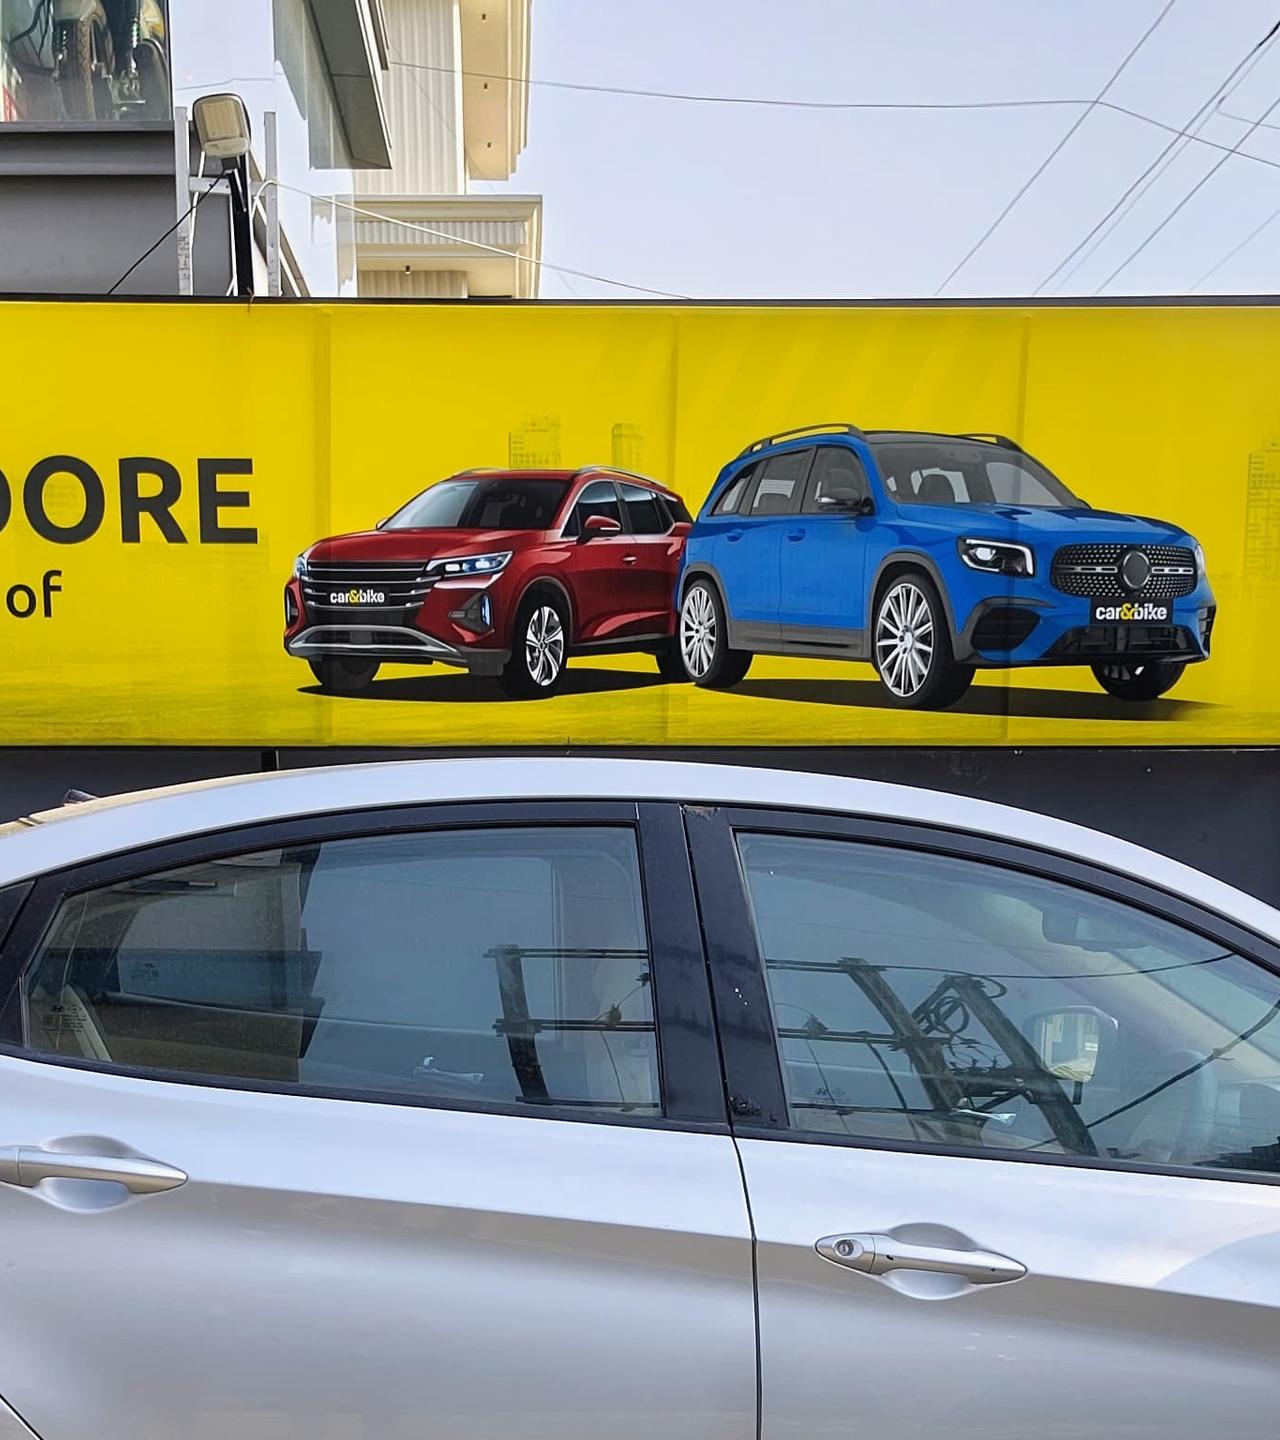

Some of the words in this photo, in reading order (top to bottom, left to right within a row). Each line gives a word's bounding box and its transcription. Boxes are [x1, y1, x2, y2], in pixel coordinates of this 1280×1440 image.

[7, 570, 63, 619] of
[330, 589, 385, 603] car&bike
[1095, 603, 1167, 620] car&bike
